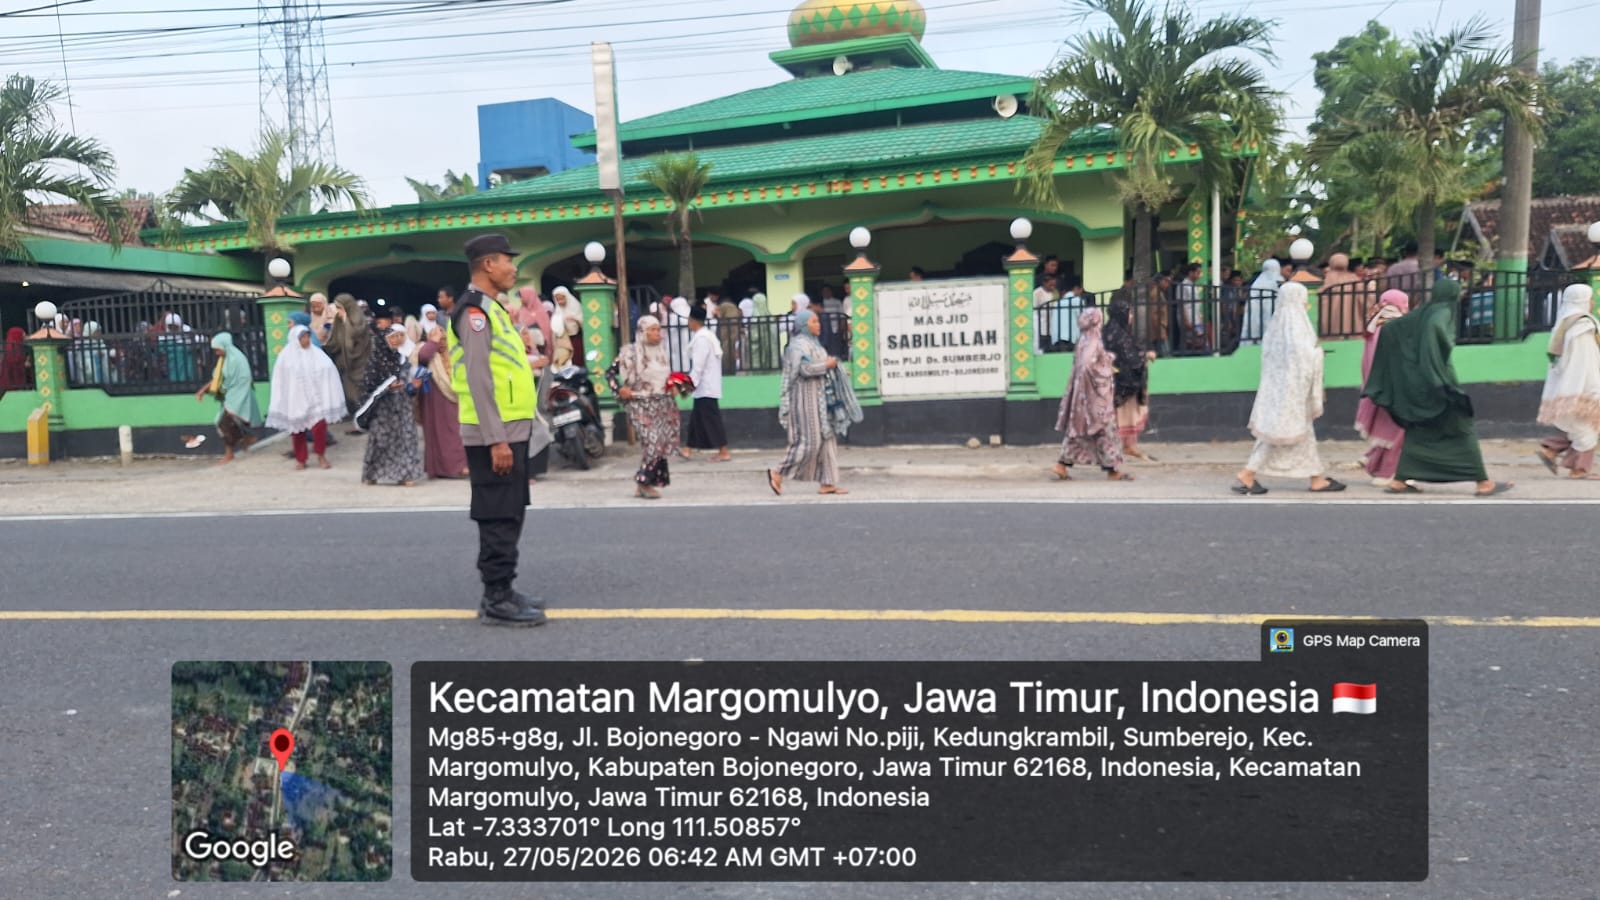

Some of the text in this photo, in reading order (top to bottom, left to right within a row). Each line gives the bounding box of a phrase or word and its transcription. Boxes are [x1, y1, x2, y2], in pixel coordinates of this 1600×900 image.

[914, 314, 969, 326] MASJID
[887, 329, 997, 350] SABILILLAH
[903, 356, 921, 365] PIJI
[942, 353, 1002, 364] SUMBERJO
